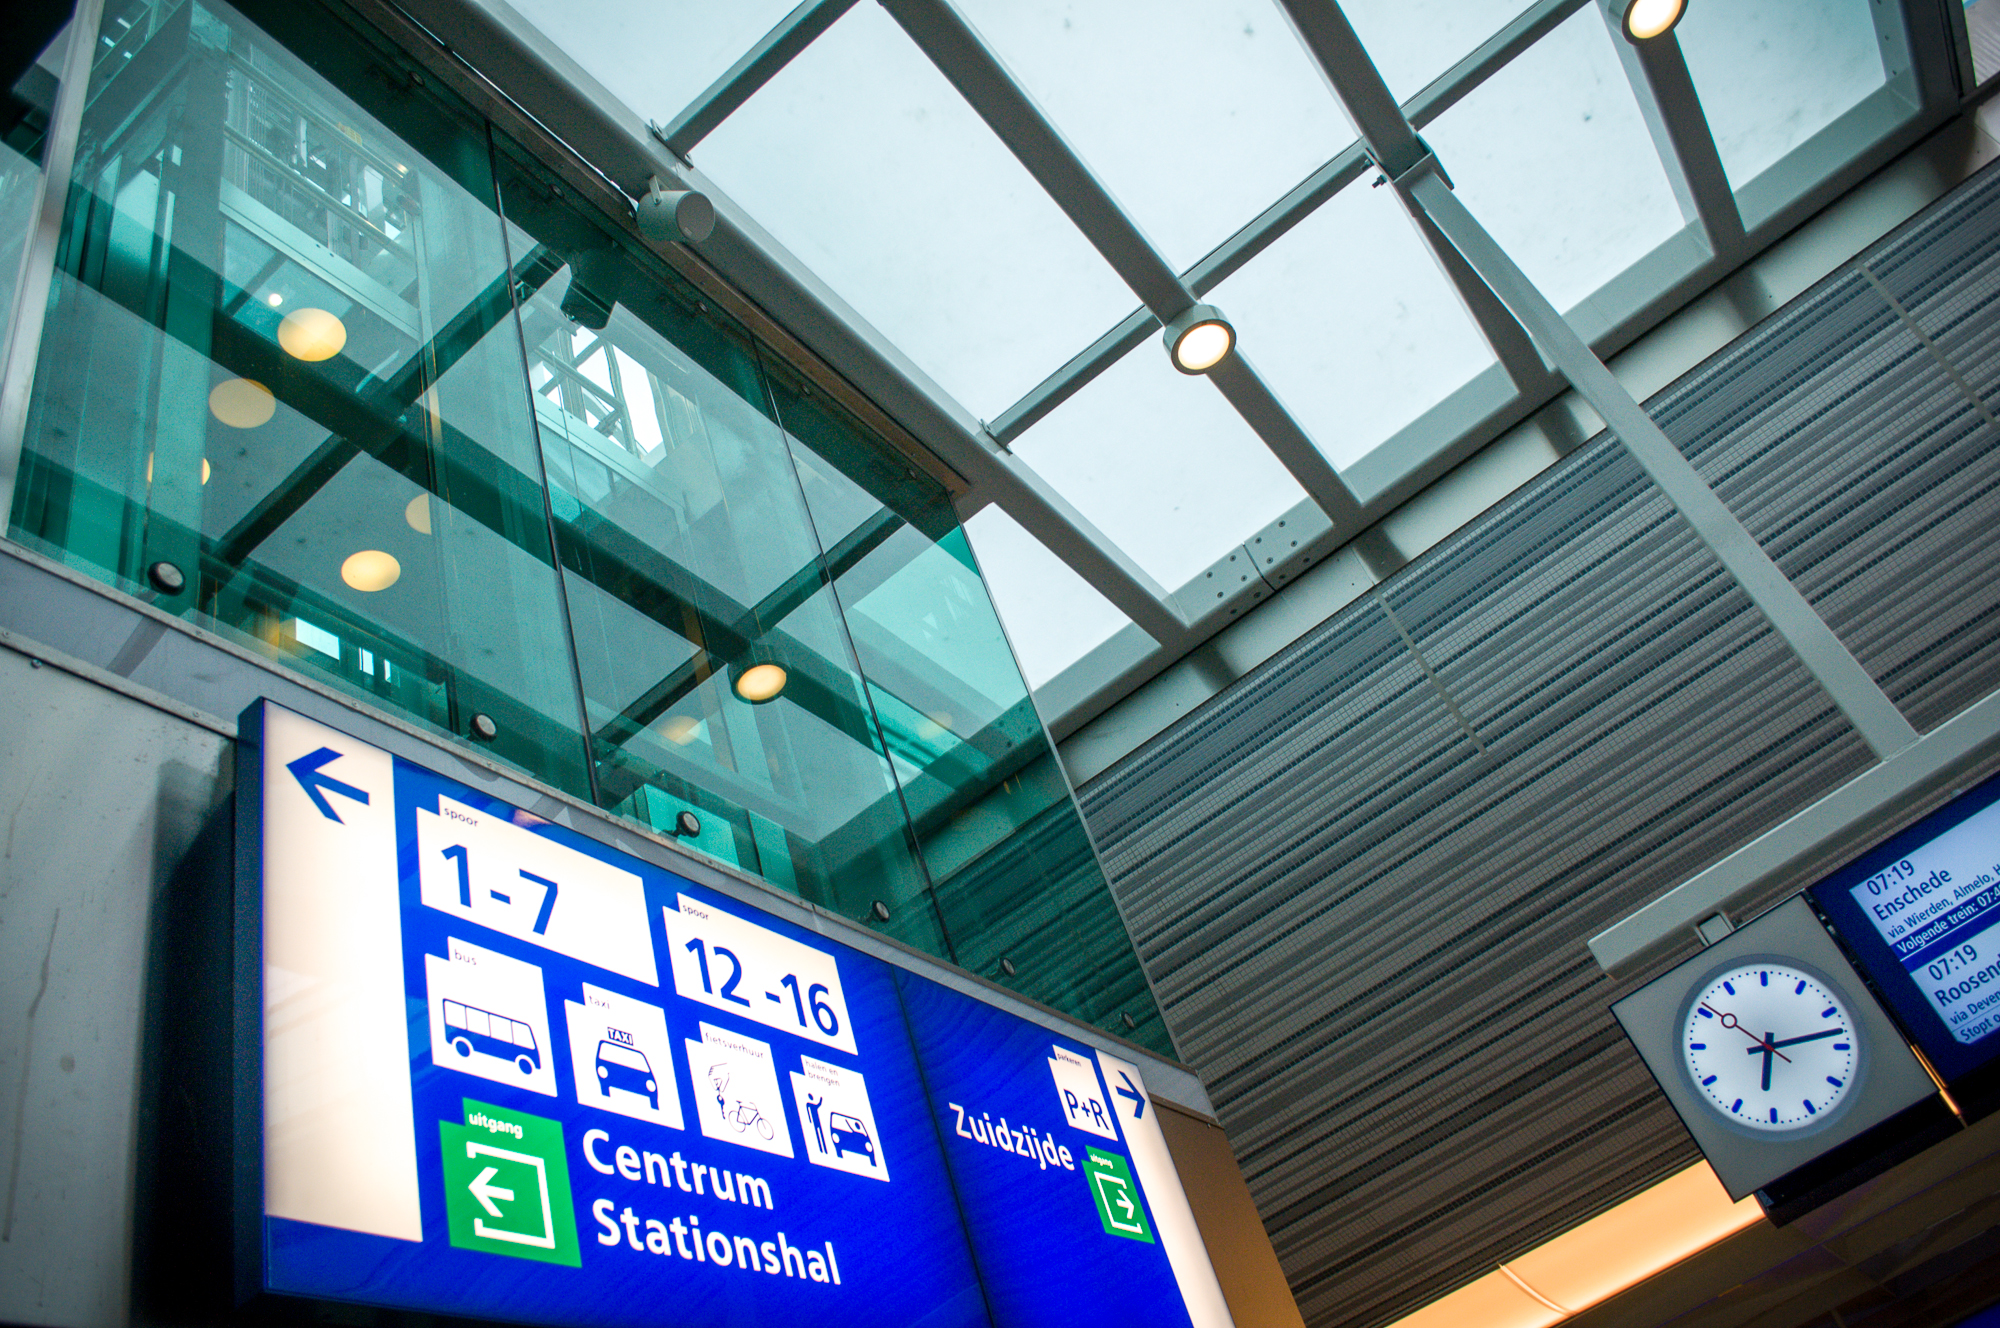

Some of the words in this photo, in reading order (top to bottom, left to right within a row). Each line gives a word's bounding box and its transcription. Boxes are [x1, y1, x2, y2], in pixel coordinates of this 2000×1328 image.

[444, 807, 479, 827] spoor
[1867, 860, 1914, 895] 07:19
[1873, 870, 1952, 921] Enschede
[1888, 924, 1906, 938] via
[1904, 898, 1954, 928] Wierden,
[1953, 874, 1995, 901] Almelo,
[682, 905, 709, 920] spoor
[1896, 921, 1949, 953] Volgende
[1947, 902, 1979, 925] trein:
[1976, 884, 2000, 907] 07:4
[454, 948, 477, 966] bus
[1928, 944, 1977, 981] 07:19
[589, 995, 610, 1010] taxi
[1950, 1011, 1968, 1025] via
[1960, 1017, 1993, 1041] Stopt
[608, 1027, 634, 1046] TAXI
[705, 1031, 764, 1059] fietsverhuur
[805, 1058, 827, 1073] halen
[829, 1067, 839, 1076] en
[808, 1069, 841, 1087] brengen
[1063, 1088, 1109, 1131] P+R
[468, 1111, 523, 1140] uitgang
[948, 1101, 1076, 1172] Zuidzijde
[582, 1128, 774, 1210] Centrum
[592, 1198, 841, 1285] Stationshal
